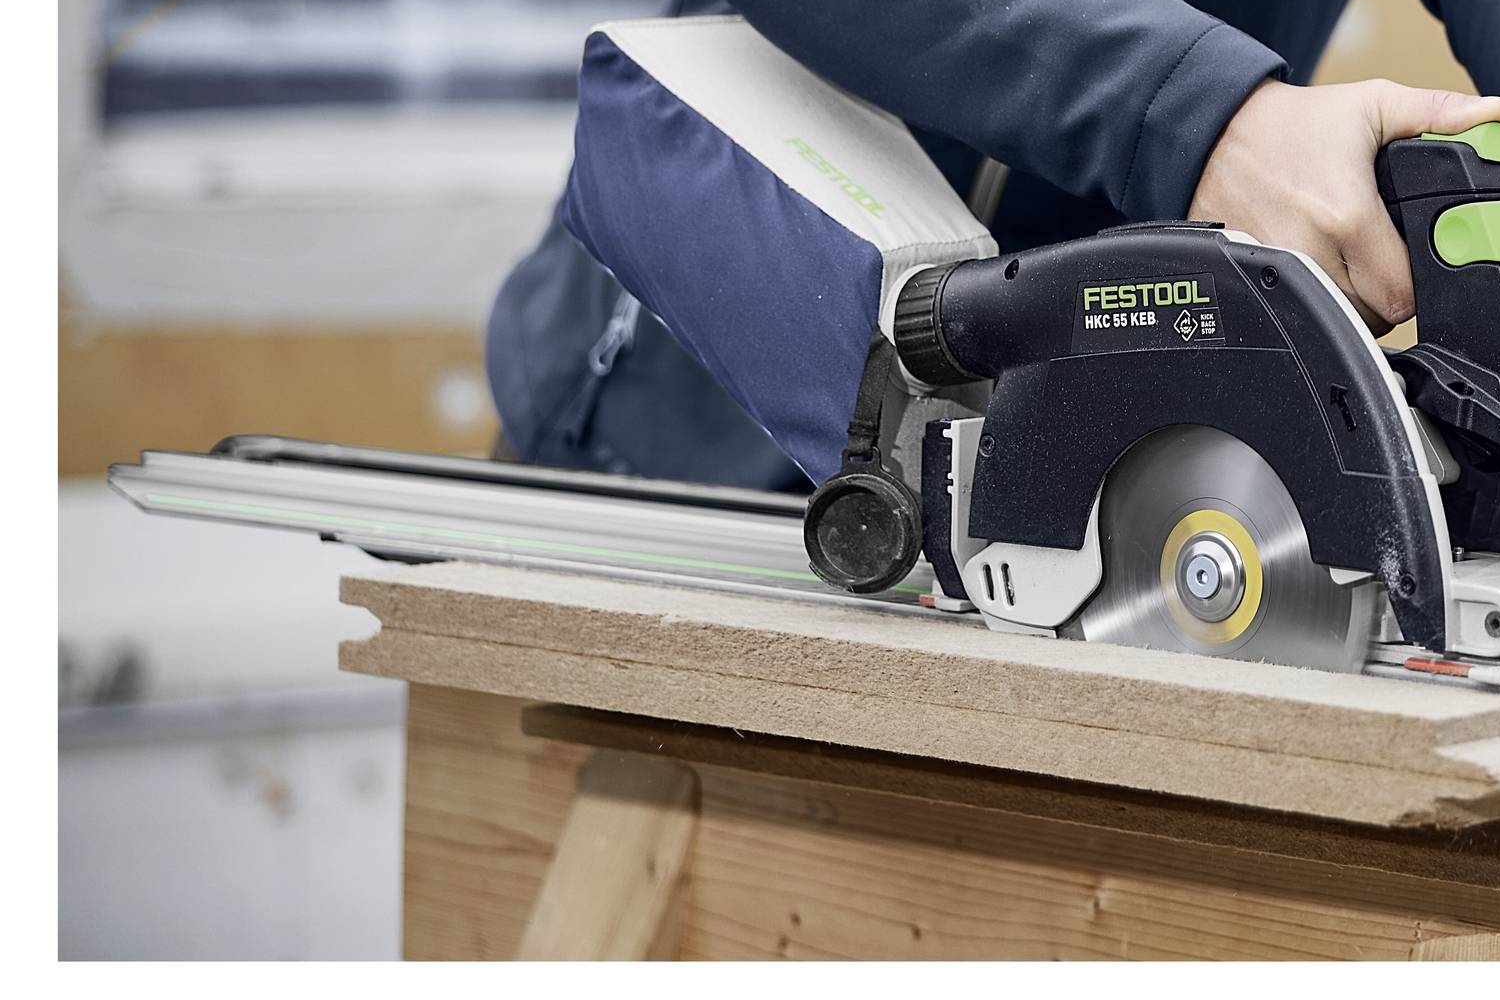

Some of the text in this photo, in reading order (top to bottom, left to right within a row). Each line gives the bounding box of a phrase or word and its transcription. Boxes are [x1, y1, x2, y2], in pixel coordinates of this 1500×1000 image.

[784, 138, 885, 218] FESTOOL
[1083, 280, 1210, 311] FESTOOL
[1085, 311, 1156, 330] HKC 55 KEB
[1200, 313, 1214, 321] KICK
[1200, 320, 1216, 328] BACK
[1201, 327, 1216, 335] STOP
